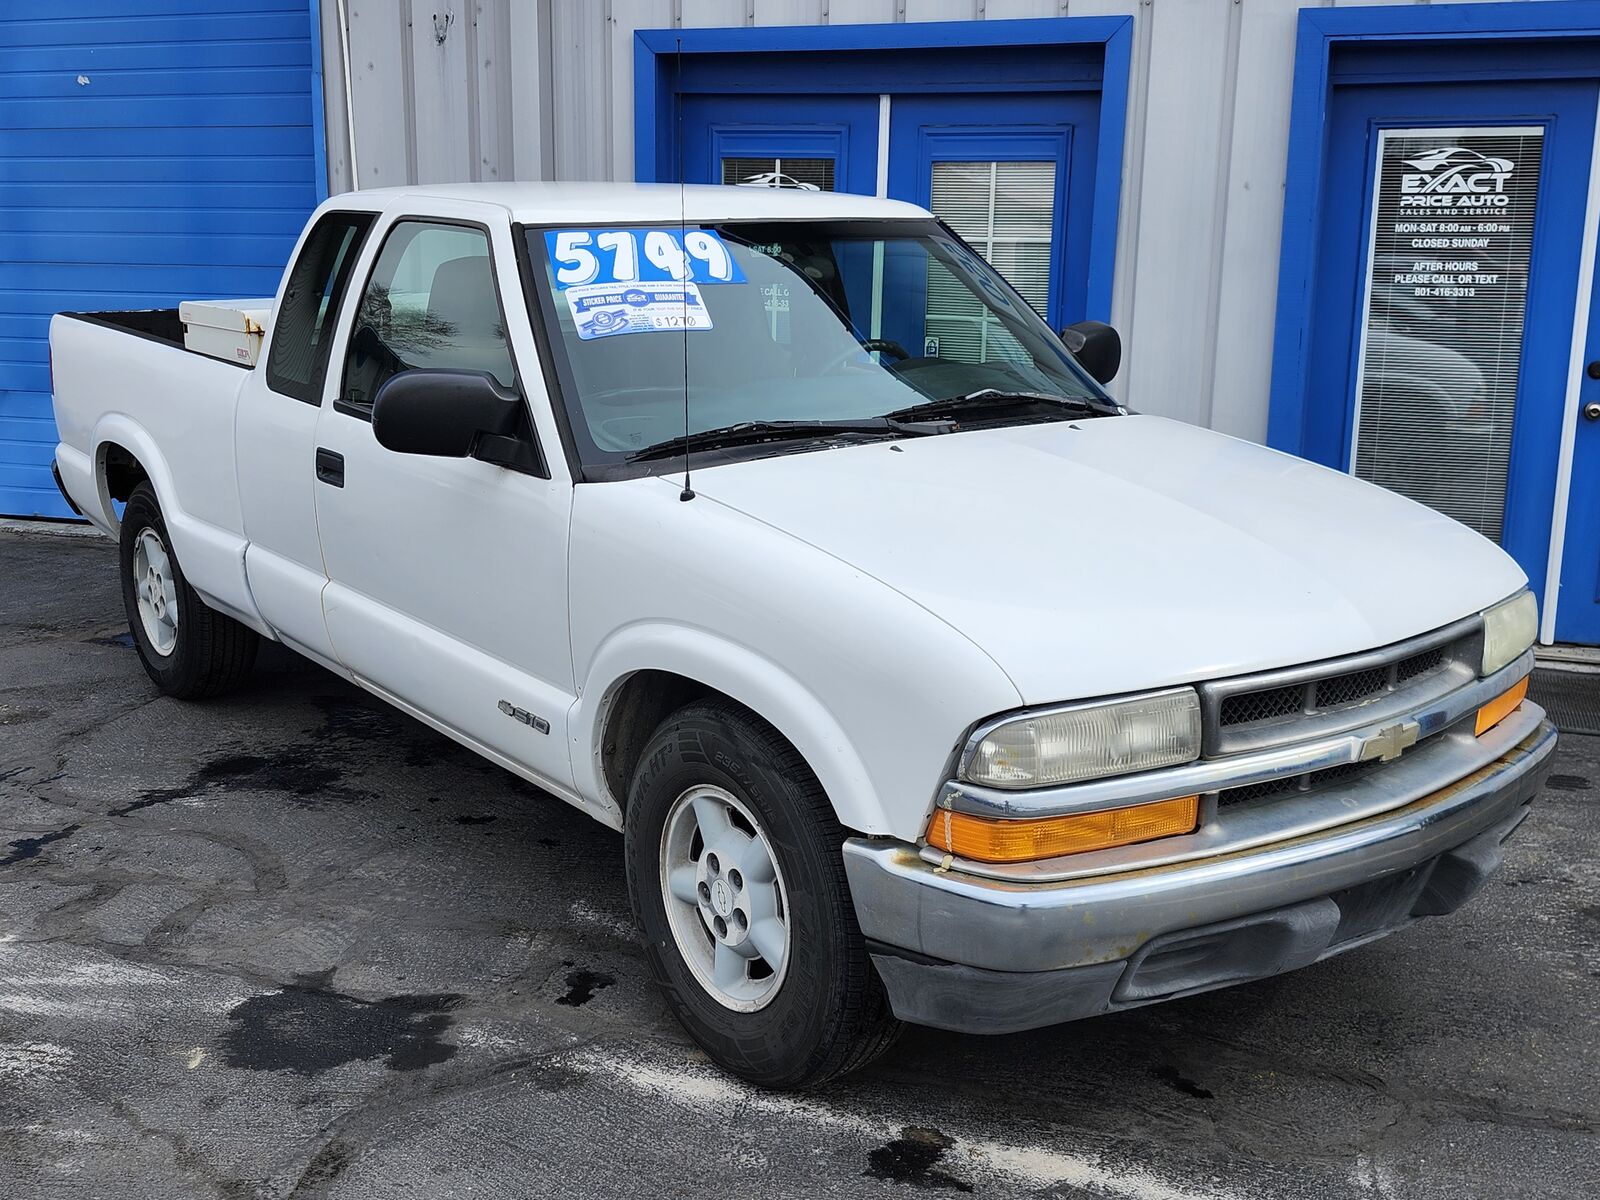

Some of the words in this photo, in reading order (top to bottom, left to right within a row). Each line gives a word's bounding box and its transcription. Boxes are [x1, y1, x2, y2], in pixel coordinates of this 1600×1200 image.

[1401, 173, 1513, 193] EXACT
[1400, 195, 1453, 206] PRICE
[1456, 195, 1509, 206] AUTO
[1394, 223, 1438, 232] MON-SAT
[1477, 223, 1498, 232] 6:00
[1412, 238, 1449, 248] CLOSED
[1451, 238, 1489, 248] SUNDAY
[554, 230, 734, 284] 5749
[1413, 262, 1444, 271] AFTER
[1445, 261, 1478, 271] HOURS
[1394, 274, 1430, 283] PLEASE
[1432, 274, 1456, 283] CALL
[1458, 274, 1472, 283] OR
[1474, 274, 1498, 283] TEXT
[1414, 287, 1475, 296] 801-416-3313
[582, 296, 606, 307] STICKER
[606, 295, 623, 304] PRICE
